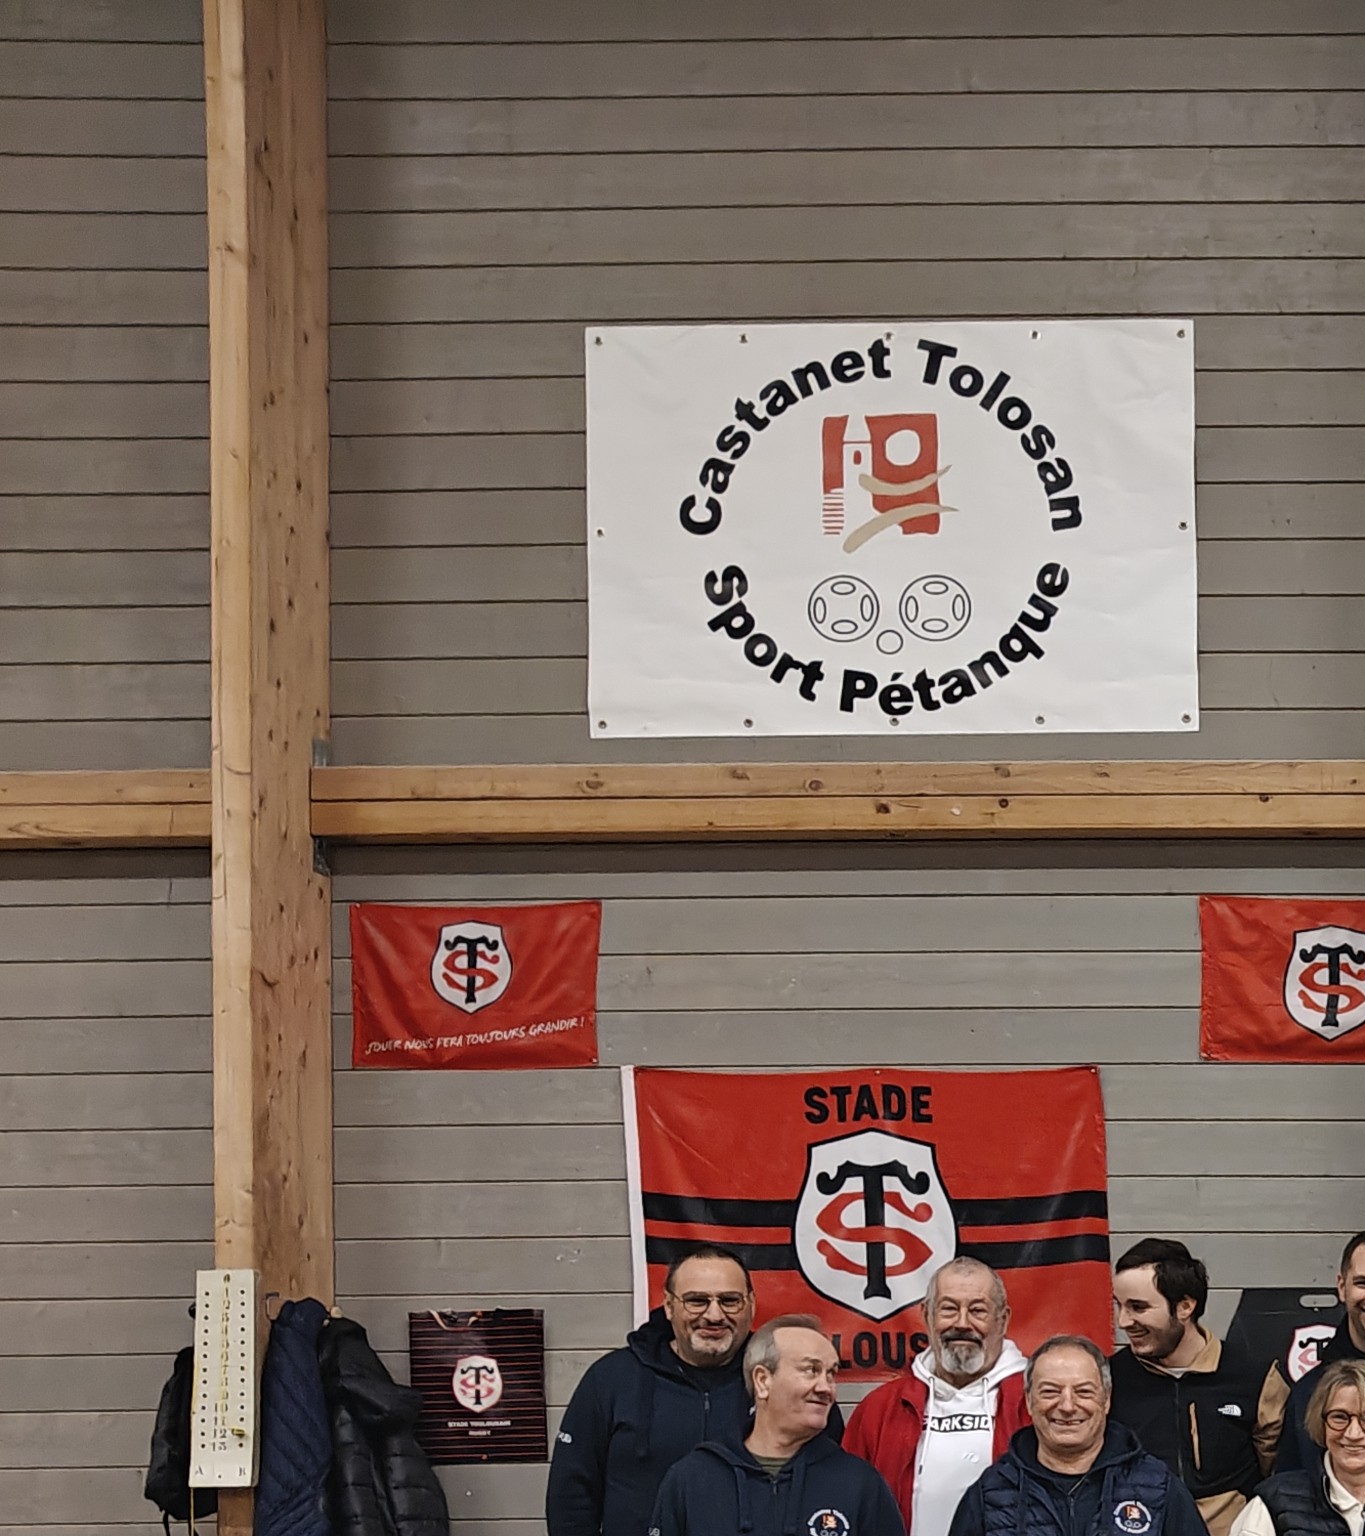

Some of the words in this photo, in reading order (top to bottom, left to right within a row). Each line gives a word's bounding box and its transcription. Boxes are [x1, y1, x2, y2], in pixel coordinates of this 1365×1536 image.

[679, 337, 892, 536] Castanet
[916, 339, 1084, 532] Tolosan
[704, 564, 825, 702] Sport
[839, 561, 1070, 716] Pétanque
[436, 1034, 463, 1048] FERA
[466, 1025, 526, 1046] TOUJOURS
[528, 1018, 578, 1037] GRANDIR
[804, 1084, 934, 1124] STADE
[922, 1415, 990, 1432] ARKSID
